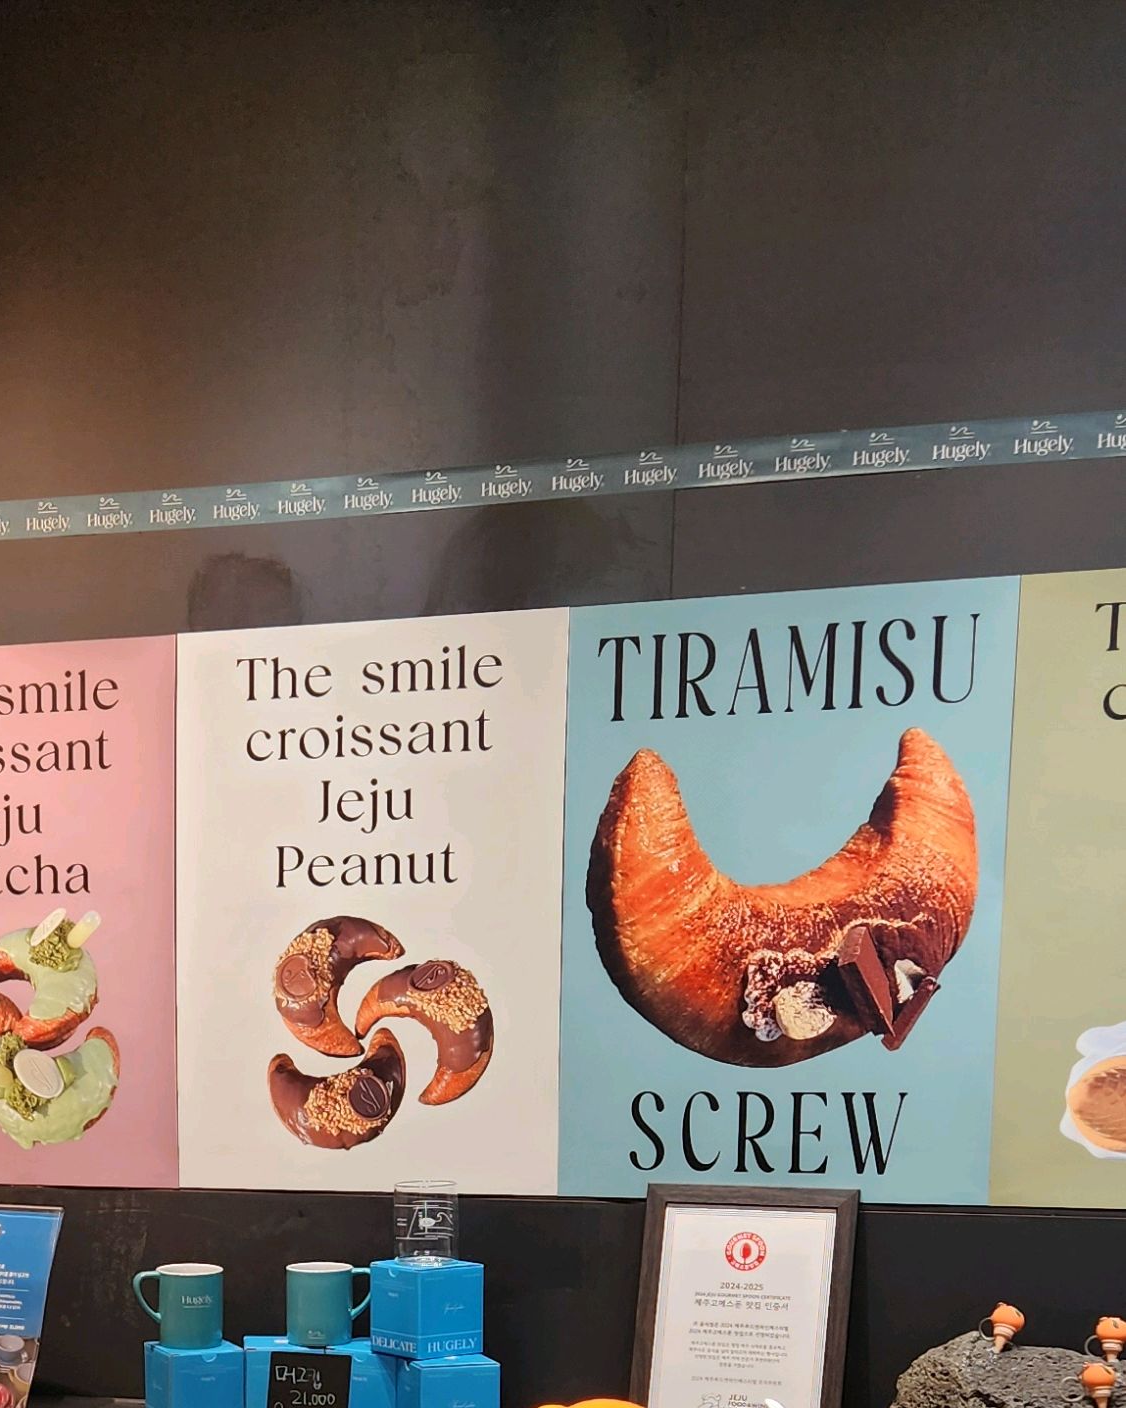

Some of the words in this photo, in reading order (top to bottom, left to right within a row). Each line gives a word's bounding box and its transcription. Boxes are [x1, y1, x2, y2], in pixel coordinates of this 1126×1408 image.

[26, 513, 70, 532] Hugely
[87, 512, 132, 529] Hugely
[149, 507, 195, 525] Hugely
[213, 502, 260, 520] Hugely
[278, 497, 325, 515] Hugely
[344, 492, 393, 510] Hugely
[412, 486, 462, 505] Hugely
[481, 479, 532, 497] Hugely
[552, 472, 604, 493] Hugely
[625, 466, 677, 485] Hugely
[699, 459, 754, 479] Hugely
[775, 452, 831, 473] Hugely
[852, 447, 910, 467] Hugely
[933, 441, 991, 461] Hugely
[1014, 435, 1074, 457] Hugely
[236, 655, 333, 702] The
[361, 645, 503, 693] smile
[598, 613, 981, 722] TIRAMISU
[245, 708, 493, 761] croissant
[319, 779, 414, 834] Jeju
[275, 843, 458, 889] Peanut
[629, 1089, 908, 1176] SCREW
[720, 1282, 764, 1291] 2024-2025
[372, 1336, 417, 1353] DELICATE
[427, 1337, 478, 1353] HUGELY
[290, 1390, 336, 1406] 21.000
